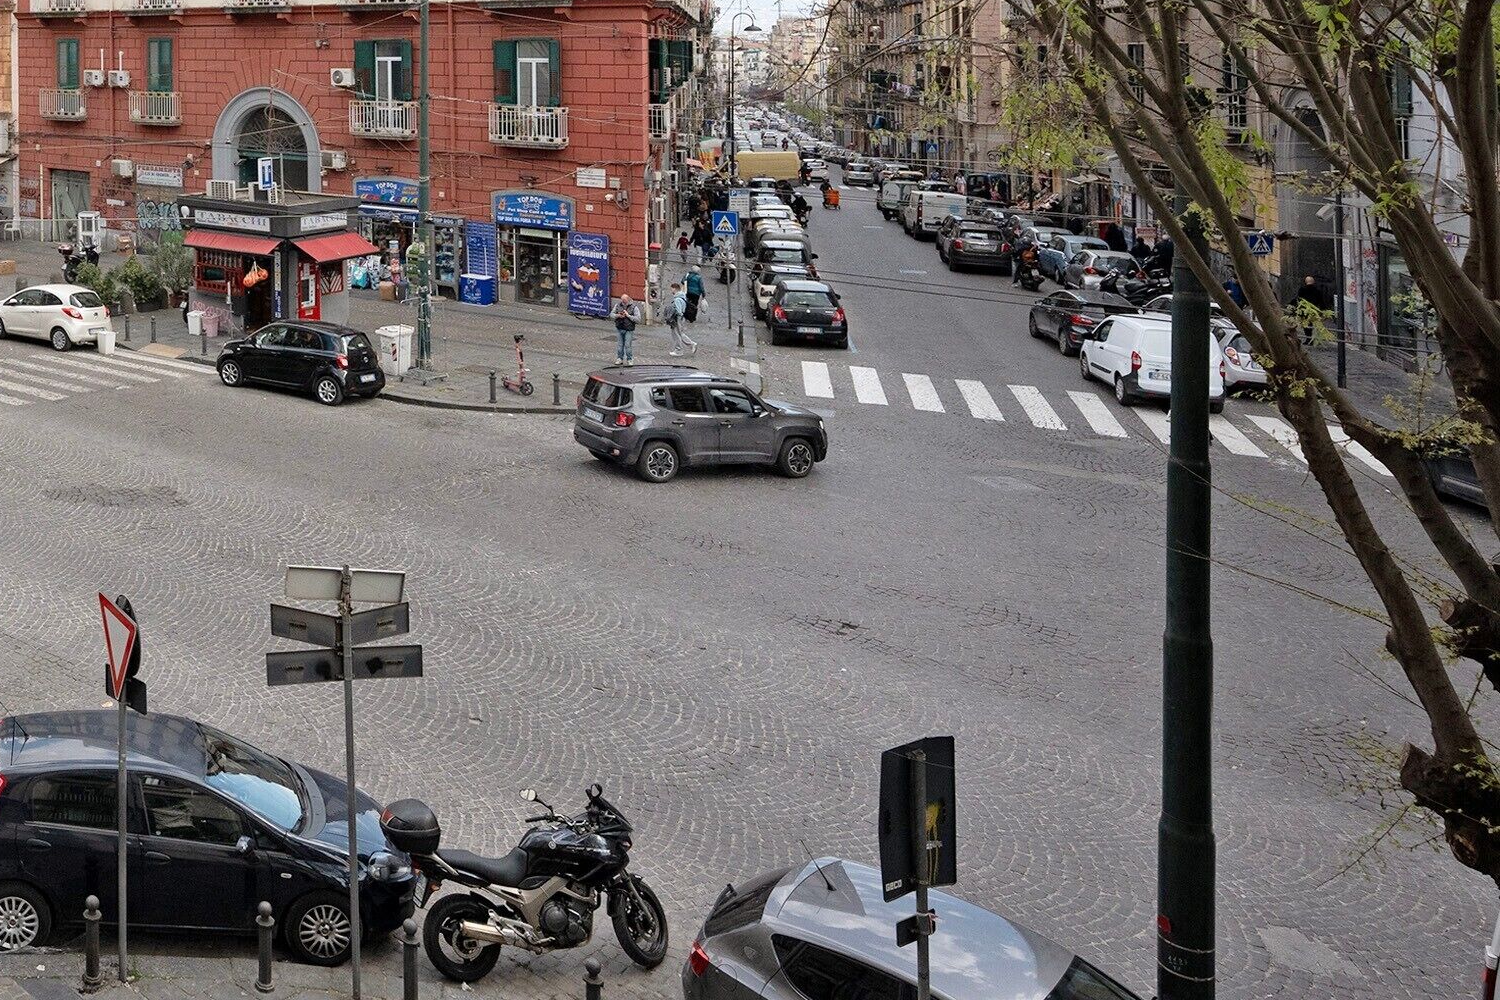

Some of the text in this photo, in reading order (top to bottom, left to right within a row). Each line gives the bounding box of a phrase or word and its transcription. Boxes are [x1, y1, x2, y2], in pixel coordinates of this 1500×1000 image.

[376, 182, 386, 190] TOP
[386, 182, 397, 190] DOG
[530, 196, 542, 204] DOG
[199, 212, 267, 226] TABACCHI
